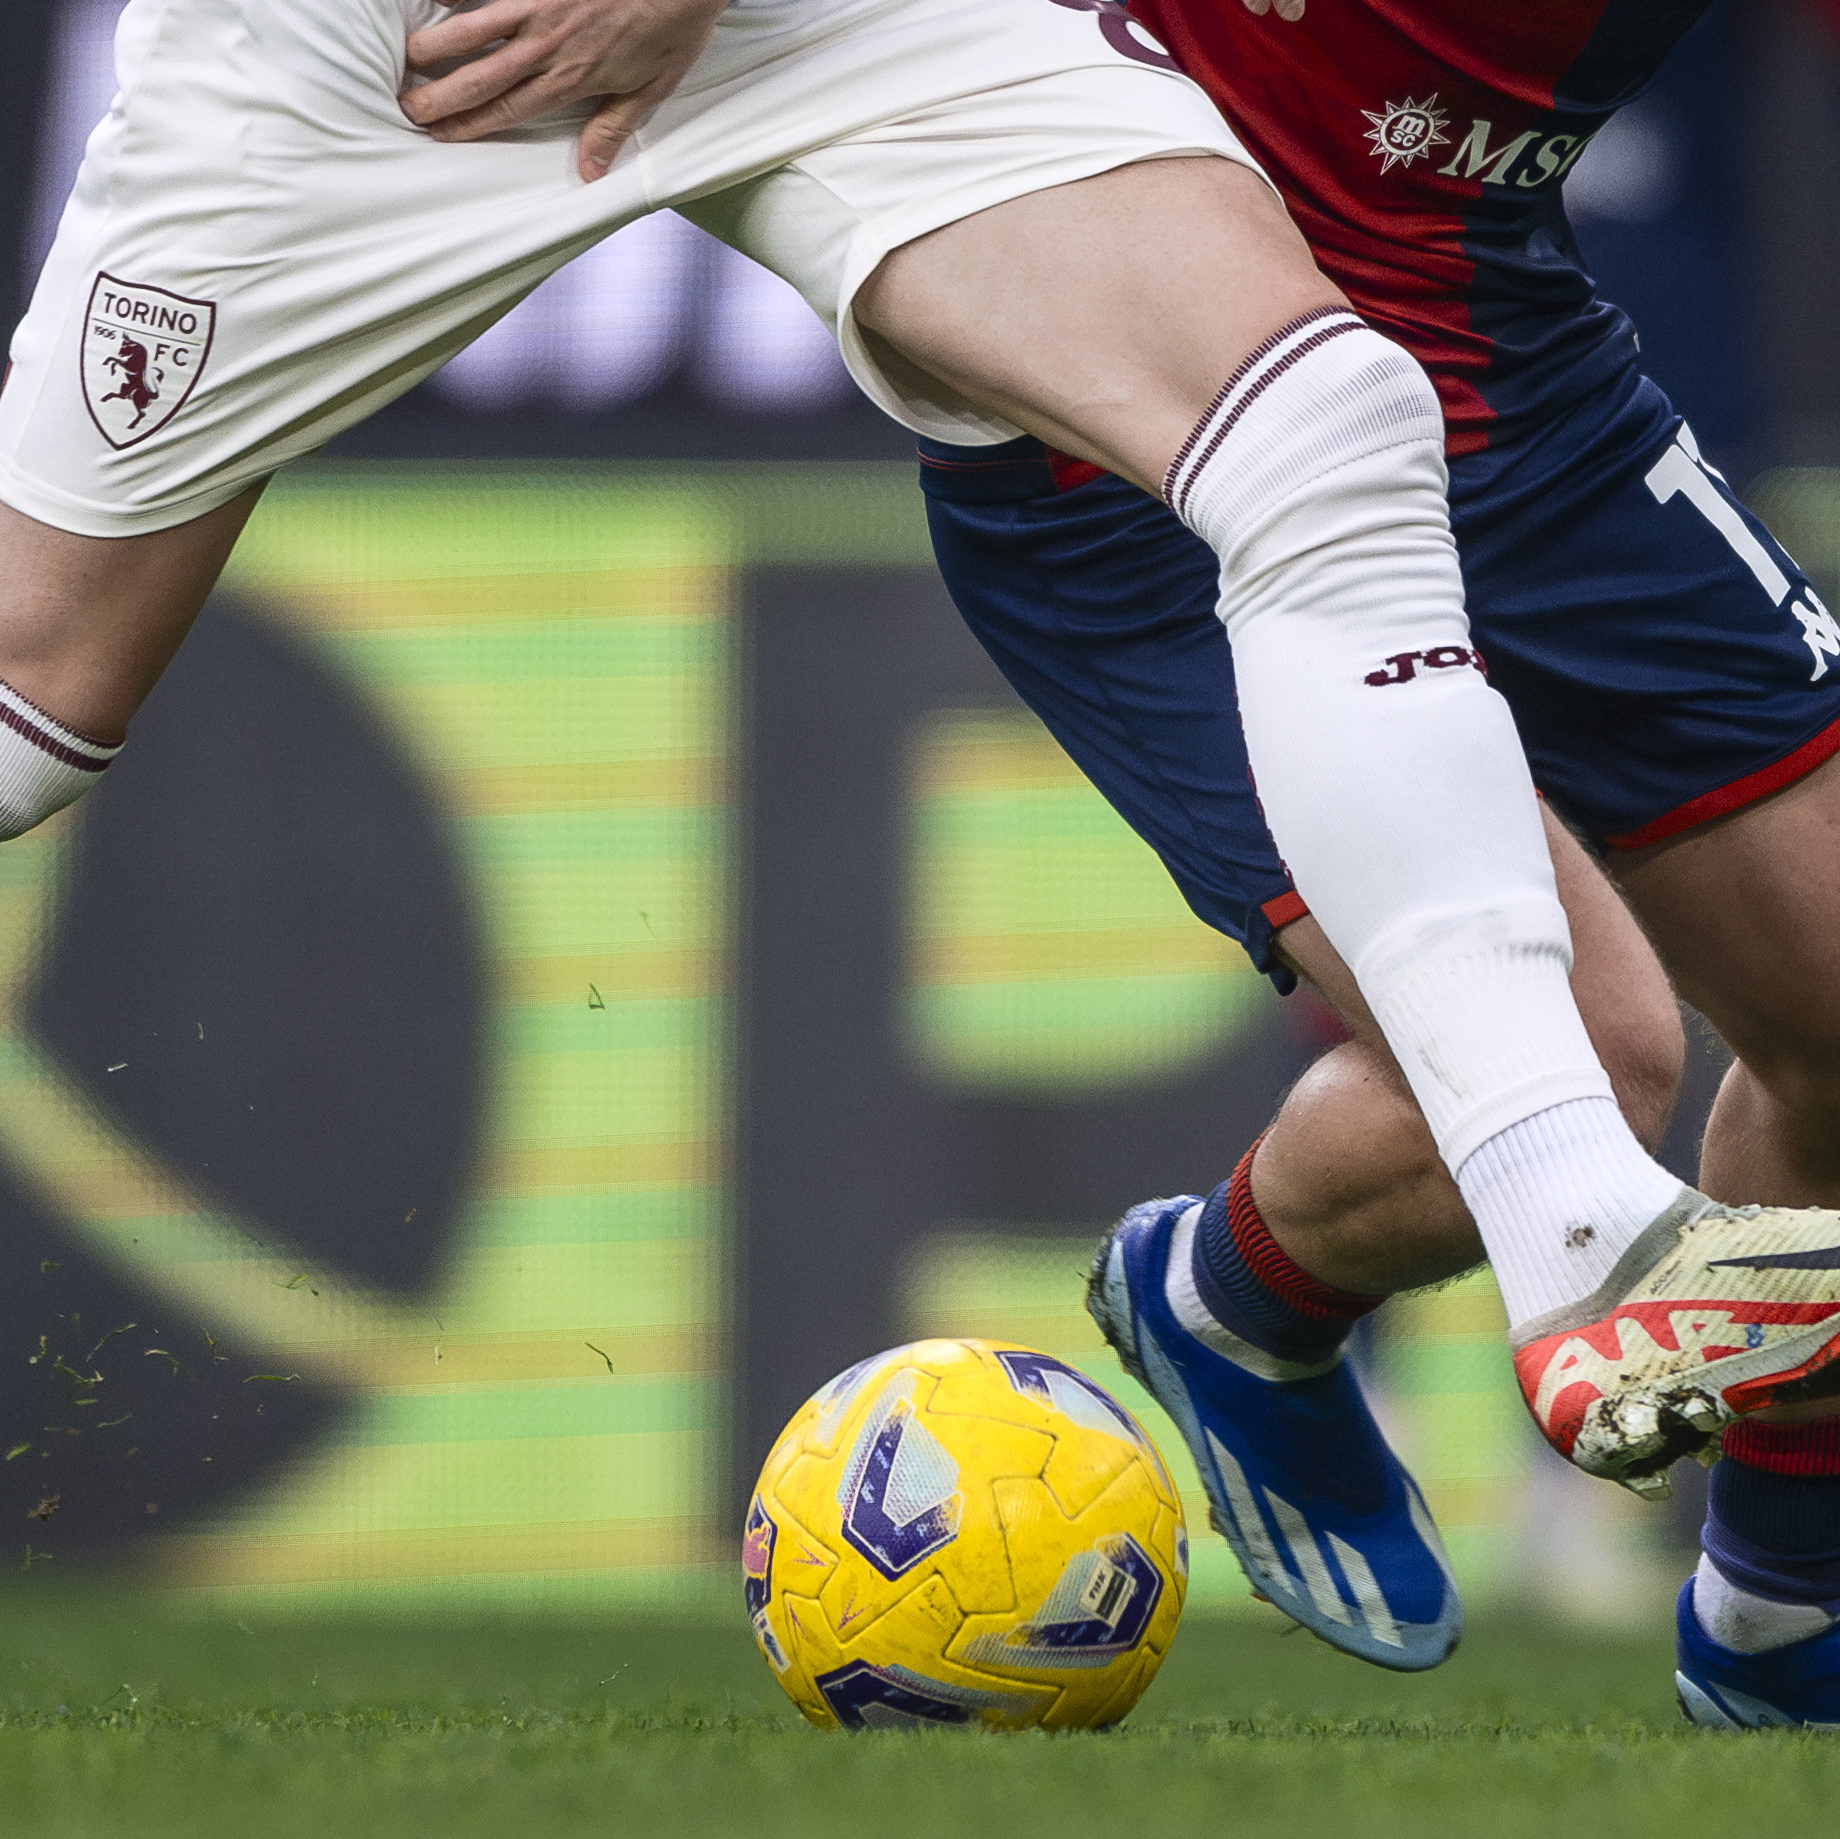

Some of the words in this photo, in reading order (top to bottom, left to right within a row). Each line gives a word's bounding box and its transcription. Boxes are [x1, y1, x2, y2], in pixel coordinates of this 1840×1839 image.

[104, 292, 197, 334] TORINO
[1645, 417, 1801, 607] 1
[1364, 645, 1488, 687] Jo
